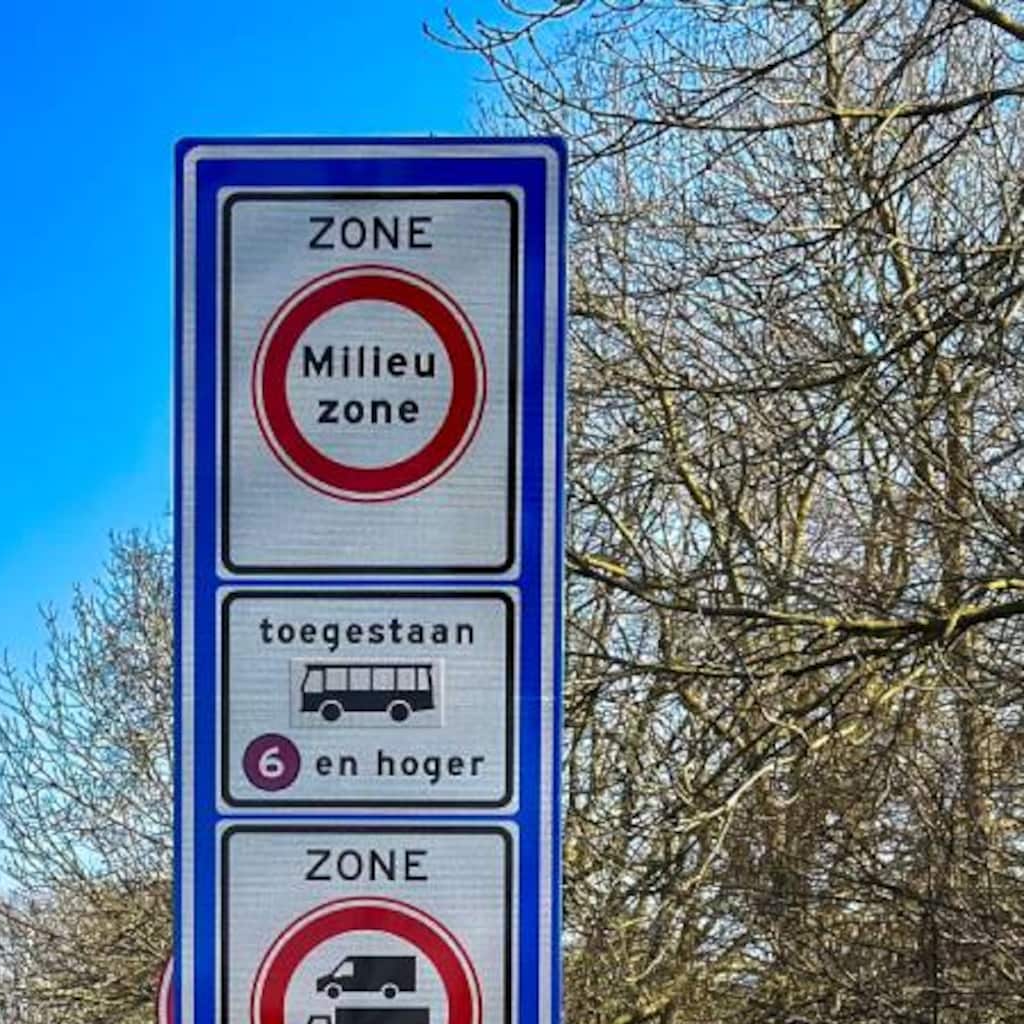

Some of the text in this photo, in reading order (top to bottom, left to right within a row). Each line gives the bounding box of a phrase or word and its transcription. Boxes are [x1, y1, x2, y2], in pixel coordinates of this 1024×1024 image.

[308, 216, 433, 249] ZONE
[303, 345, 435, 378] Milieu
[317, 400, 420, 424] zone
[260, 617, 475, 653] toegestaan
[257, 746, 486, 785] 6 en hoger
[305, 849, 429, 881] ZONE
